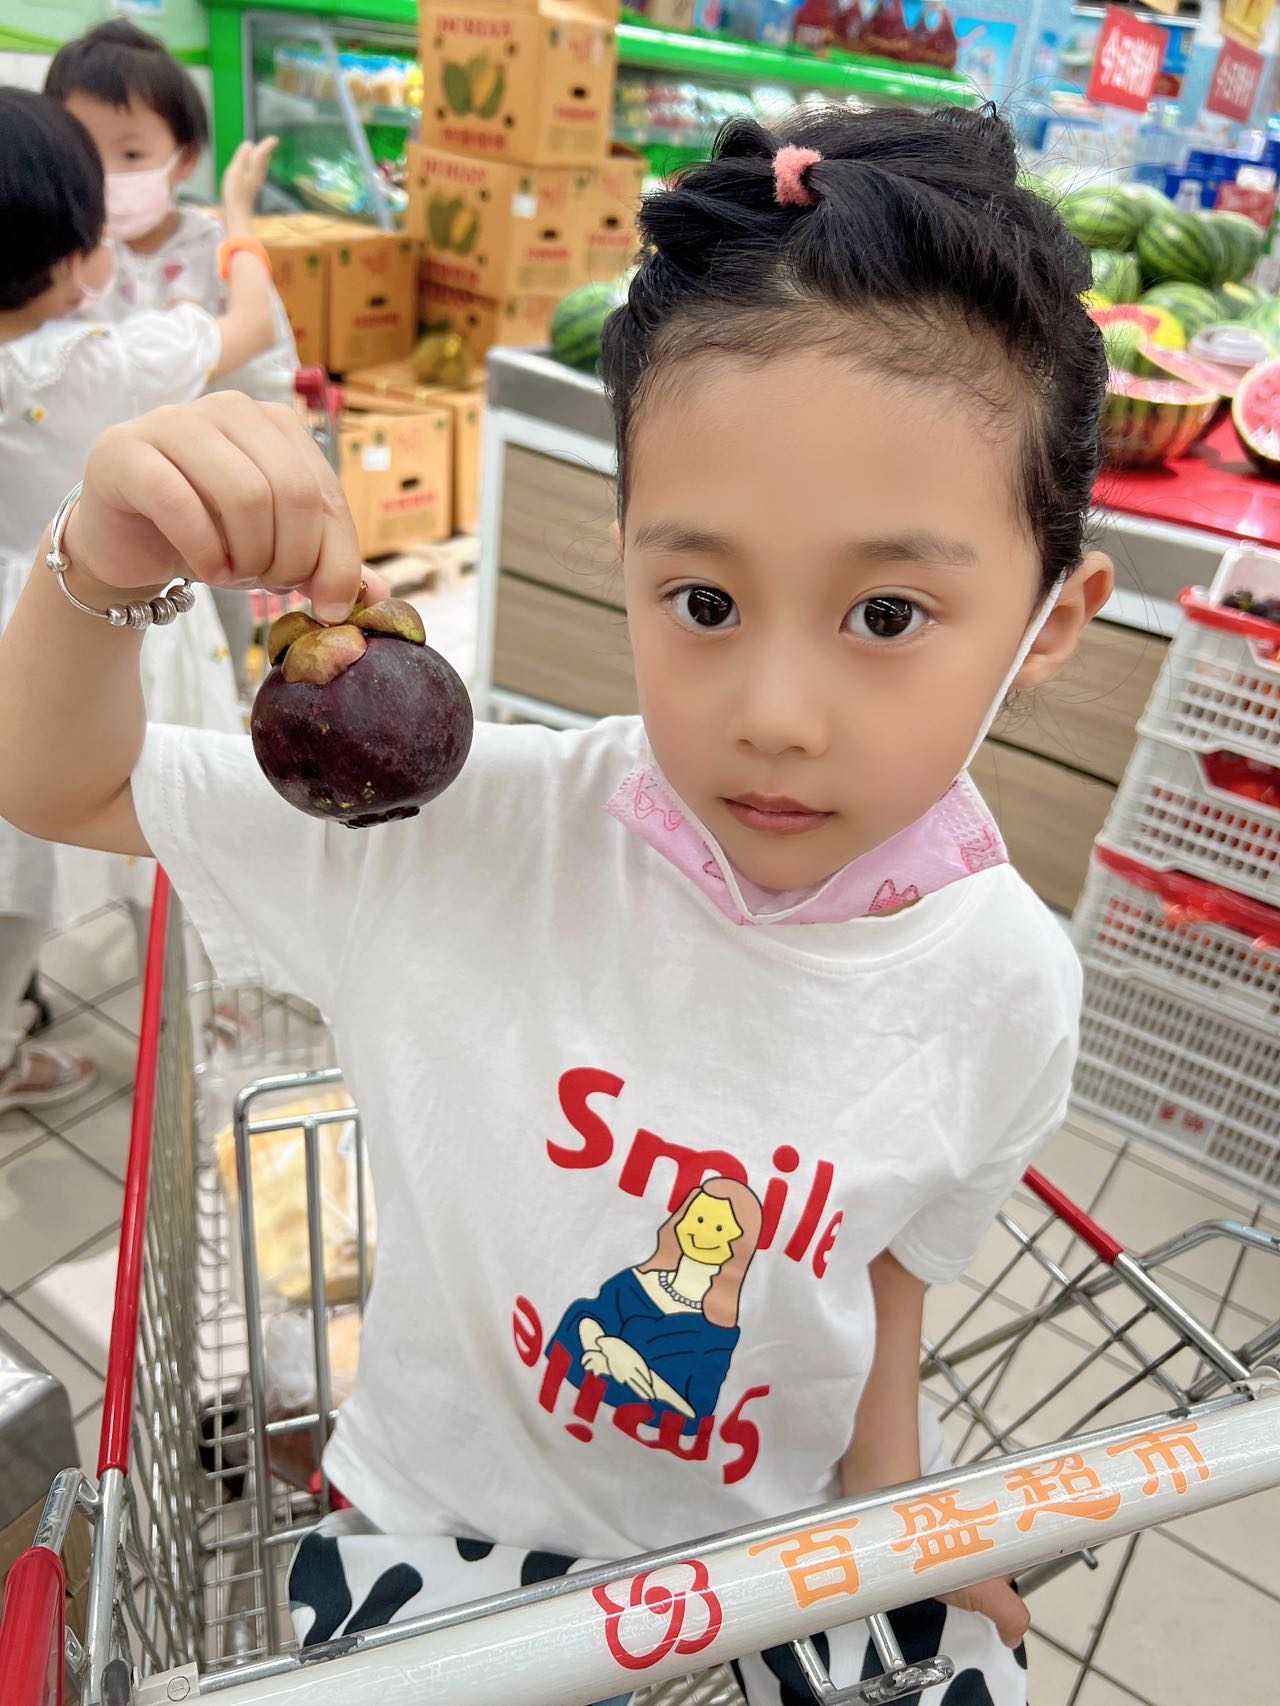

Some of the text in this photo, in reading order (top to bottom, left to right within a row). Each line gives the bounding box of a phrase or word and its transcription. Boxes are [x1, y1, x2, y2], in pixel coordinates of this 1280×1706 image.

[545, 1066, 844, 1279] Smile
[512, 1295, 770, 1485] Smile
[748, 1423, 1210, 1608] 百盛超市
